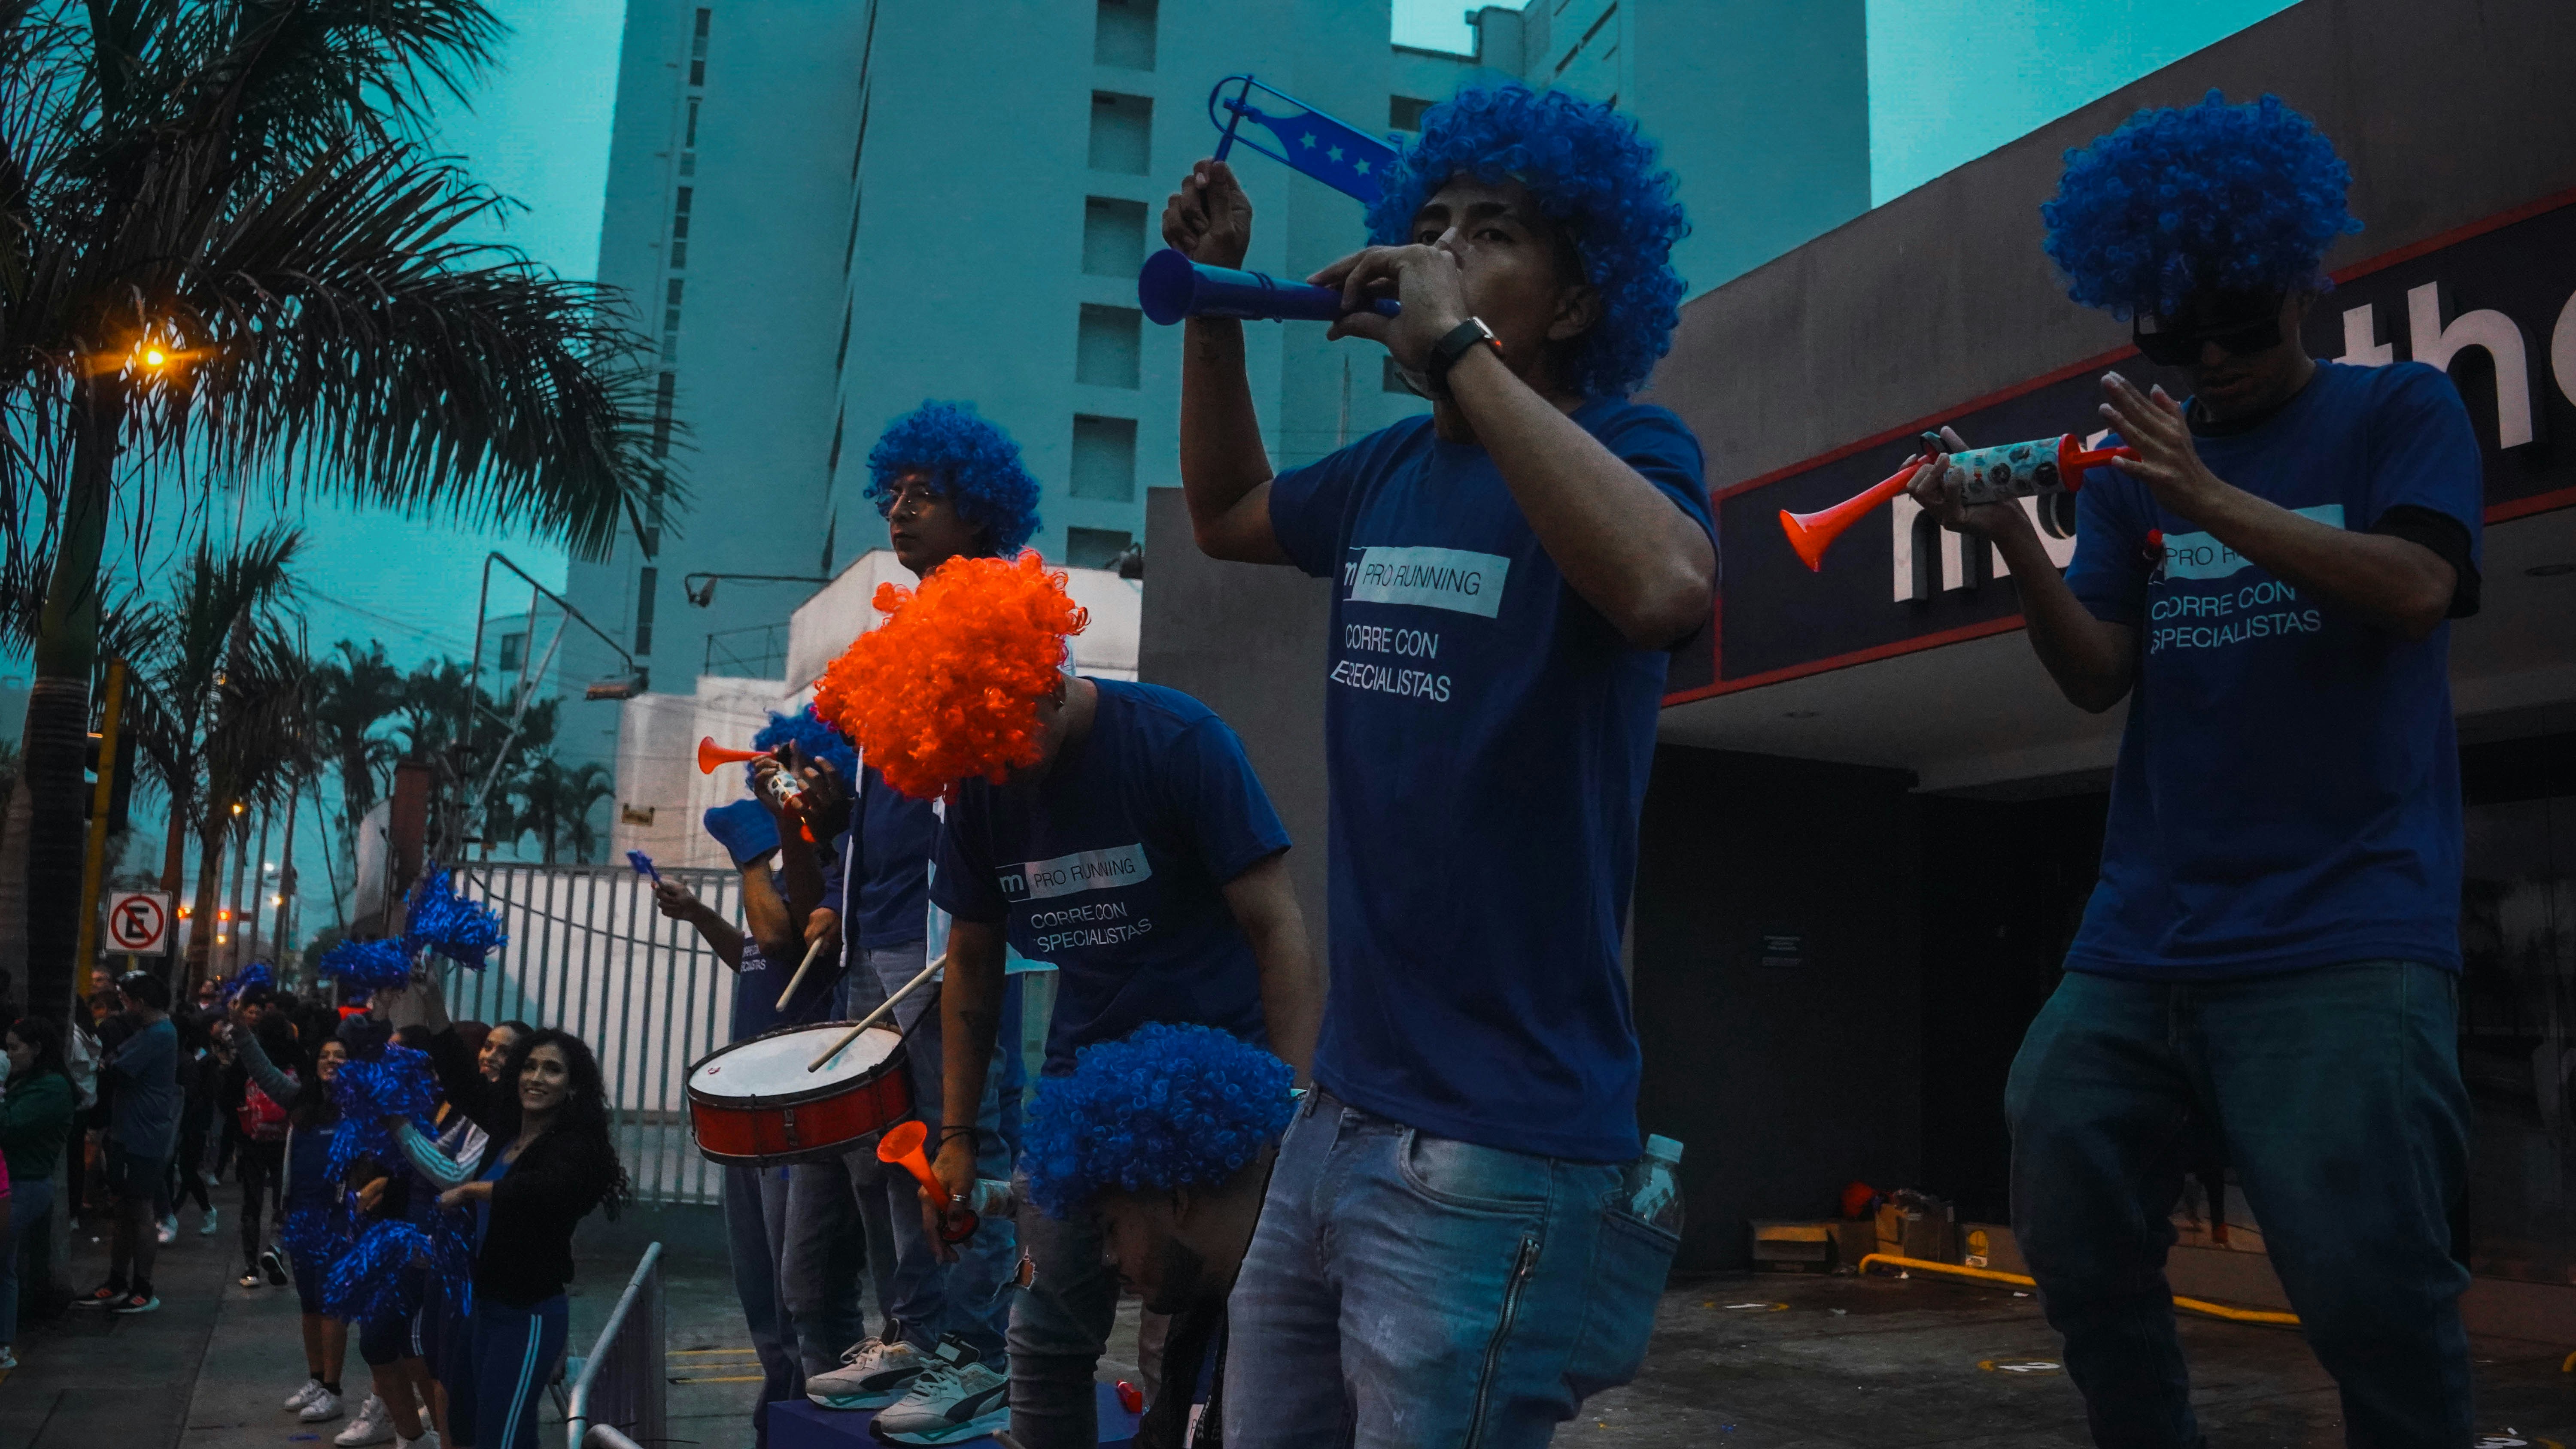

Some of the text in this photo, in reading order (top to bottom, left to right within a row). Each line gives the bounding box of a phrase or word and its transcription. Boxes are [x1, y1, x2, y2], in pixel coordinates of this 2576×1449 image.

[2165, 546, 2213, 566] PRO
[1363, 564, 1393, 587] PRO
[1394, 565, 1481, 595] RUNNING
[2151, 580, 2296, 621] CORRE CON
[1346, 623, 1439, 659] CORRE CON
[999, 858, 1135, 893] m PRO RUNNING
[125, 906, 149, 935] E
[1030, 902, 1128, 929] CORRE CON
